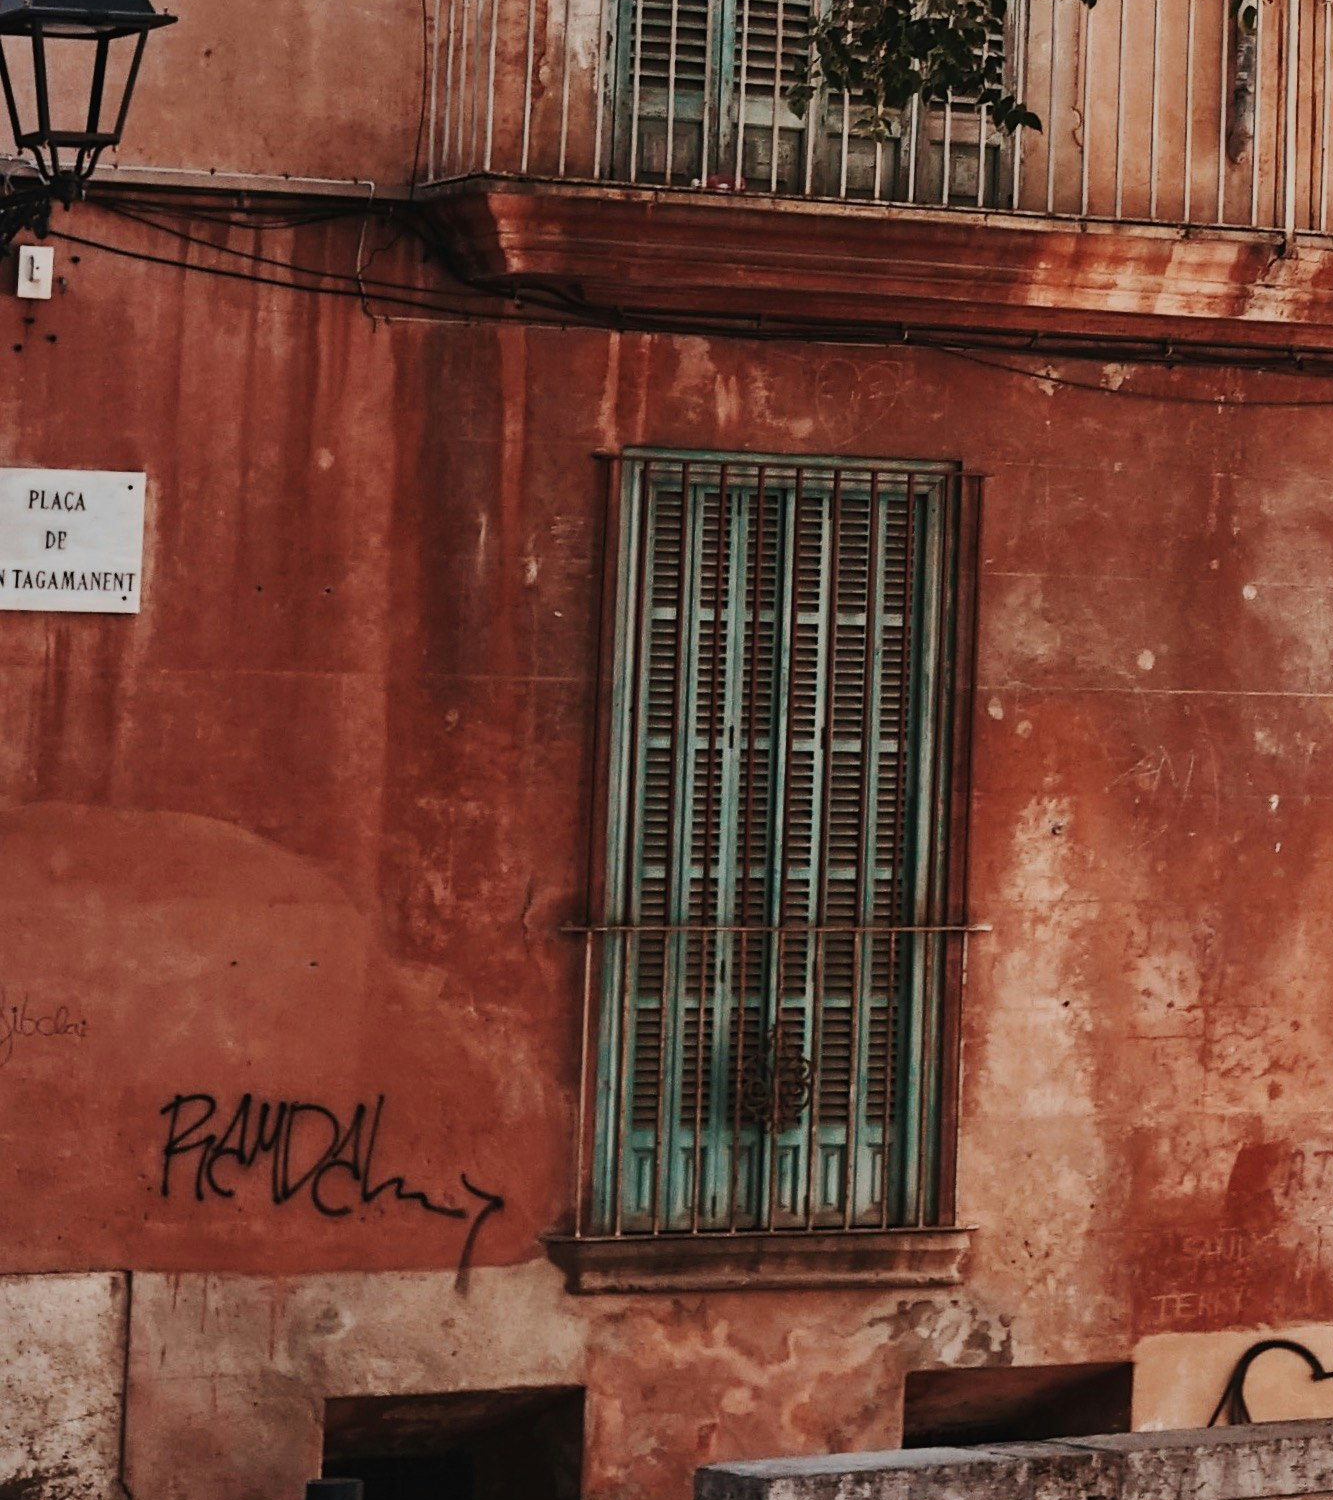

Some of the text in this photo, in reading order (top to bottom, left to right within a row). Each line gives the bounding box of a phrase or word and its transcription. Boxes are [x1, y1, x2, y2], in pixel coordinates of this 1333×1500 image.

[28, 490, 86, 512] PLAÇA
[45, 531, 67, 549] DE
[12, 569, 136, 592] TAGAMANENT
